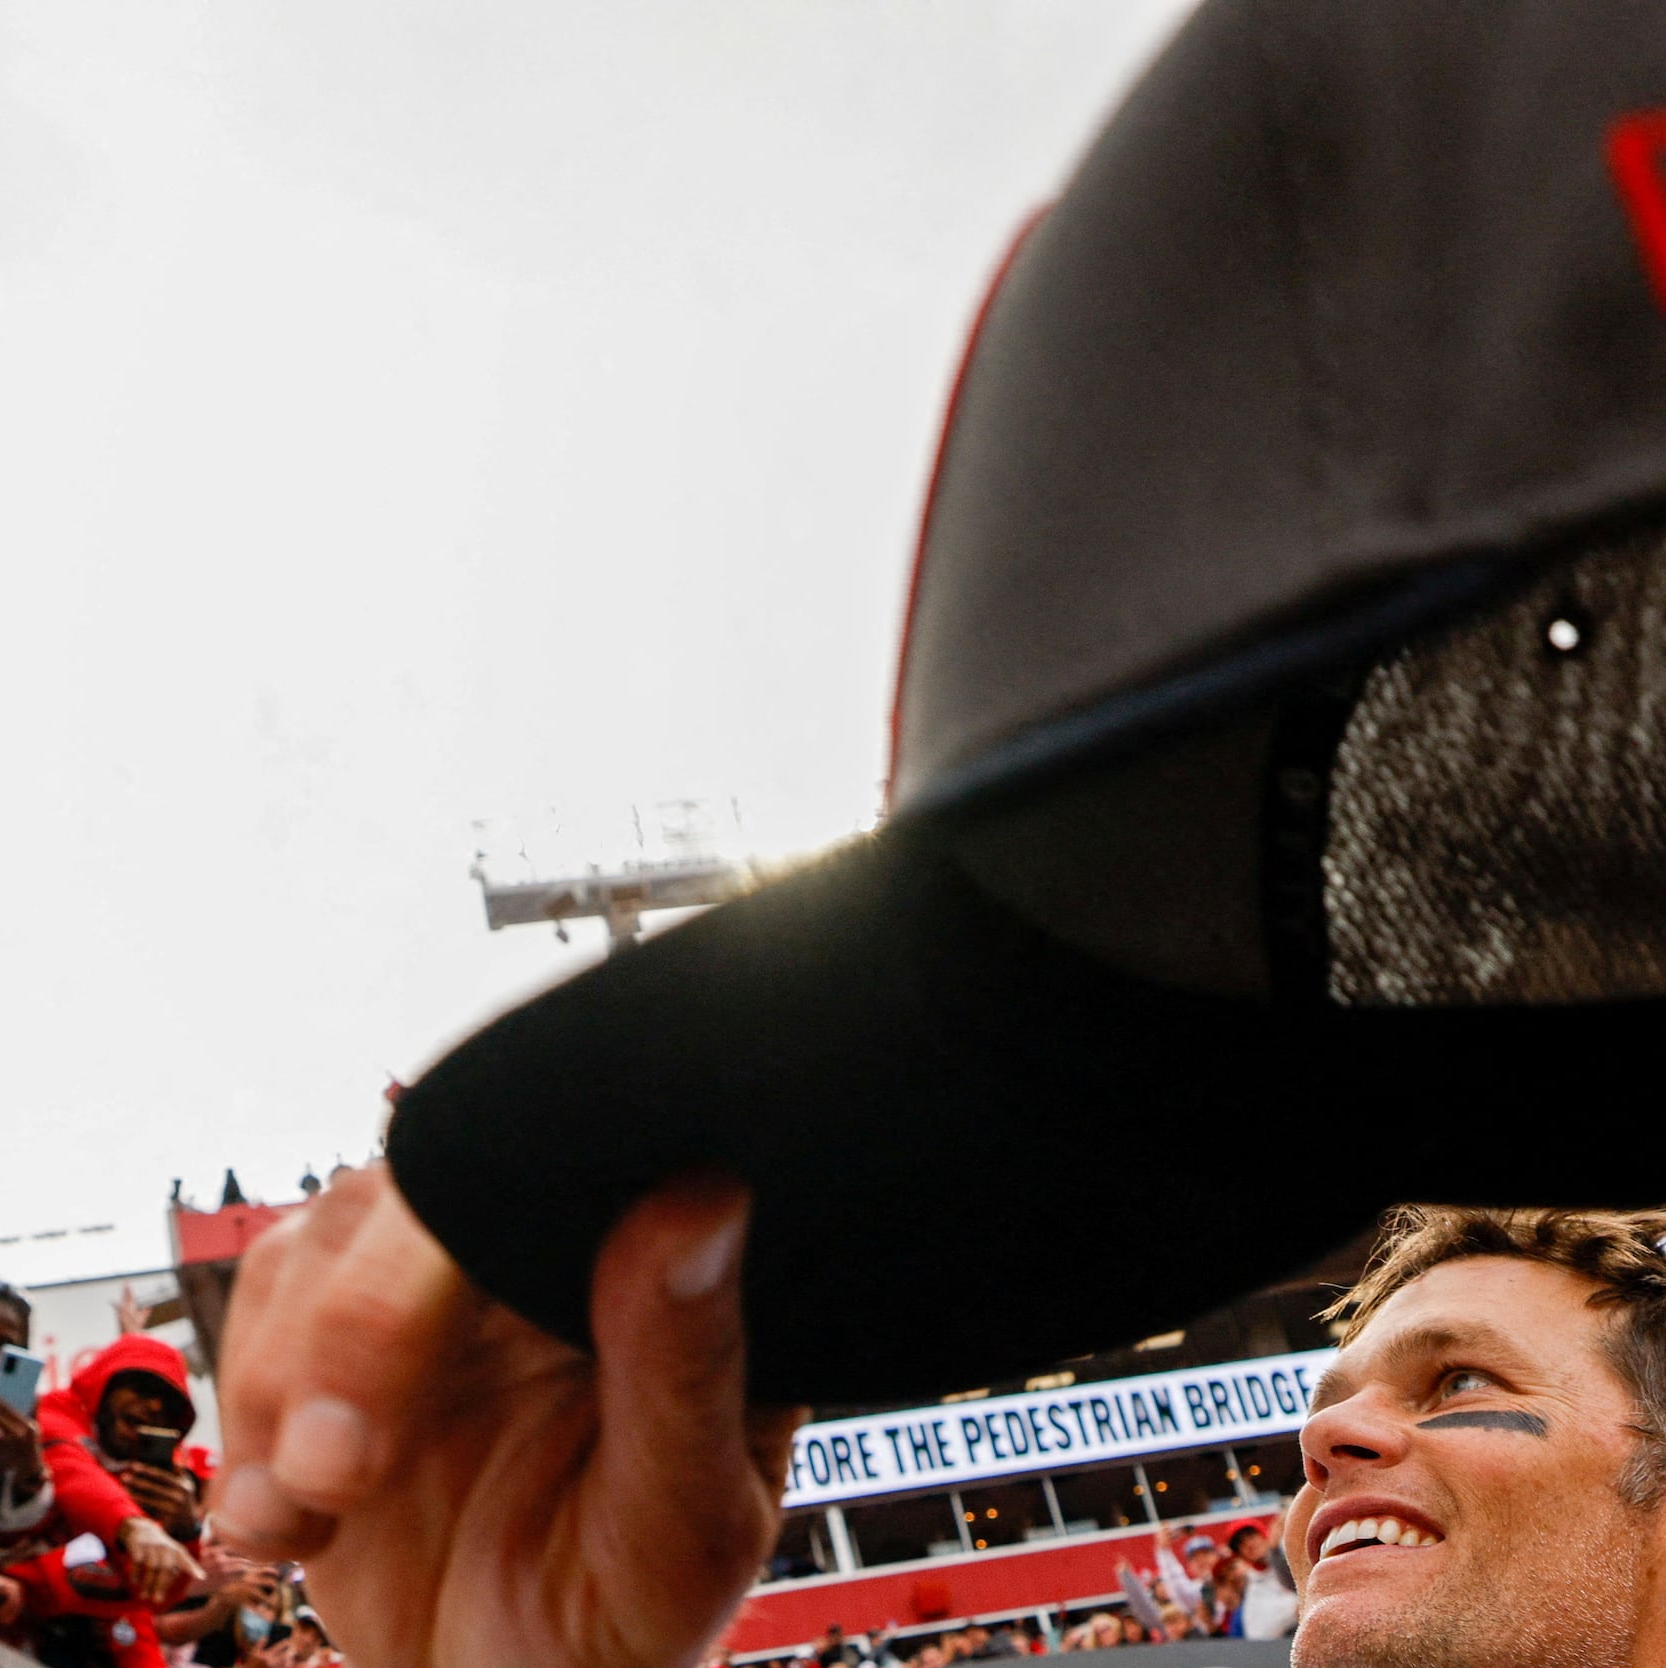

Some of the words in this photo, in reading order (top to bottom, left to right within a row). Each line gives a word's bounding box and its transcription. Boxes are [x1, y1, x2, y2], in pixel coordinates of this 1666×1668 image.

[785, 1433, 879, 1491] FORE
[884, 1421, 955, 1476] THE
[960, 1386, 1180, 1465] PEDESTRIAN
[1183, 1367, 1312, 1428] BRIDGE
